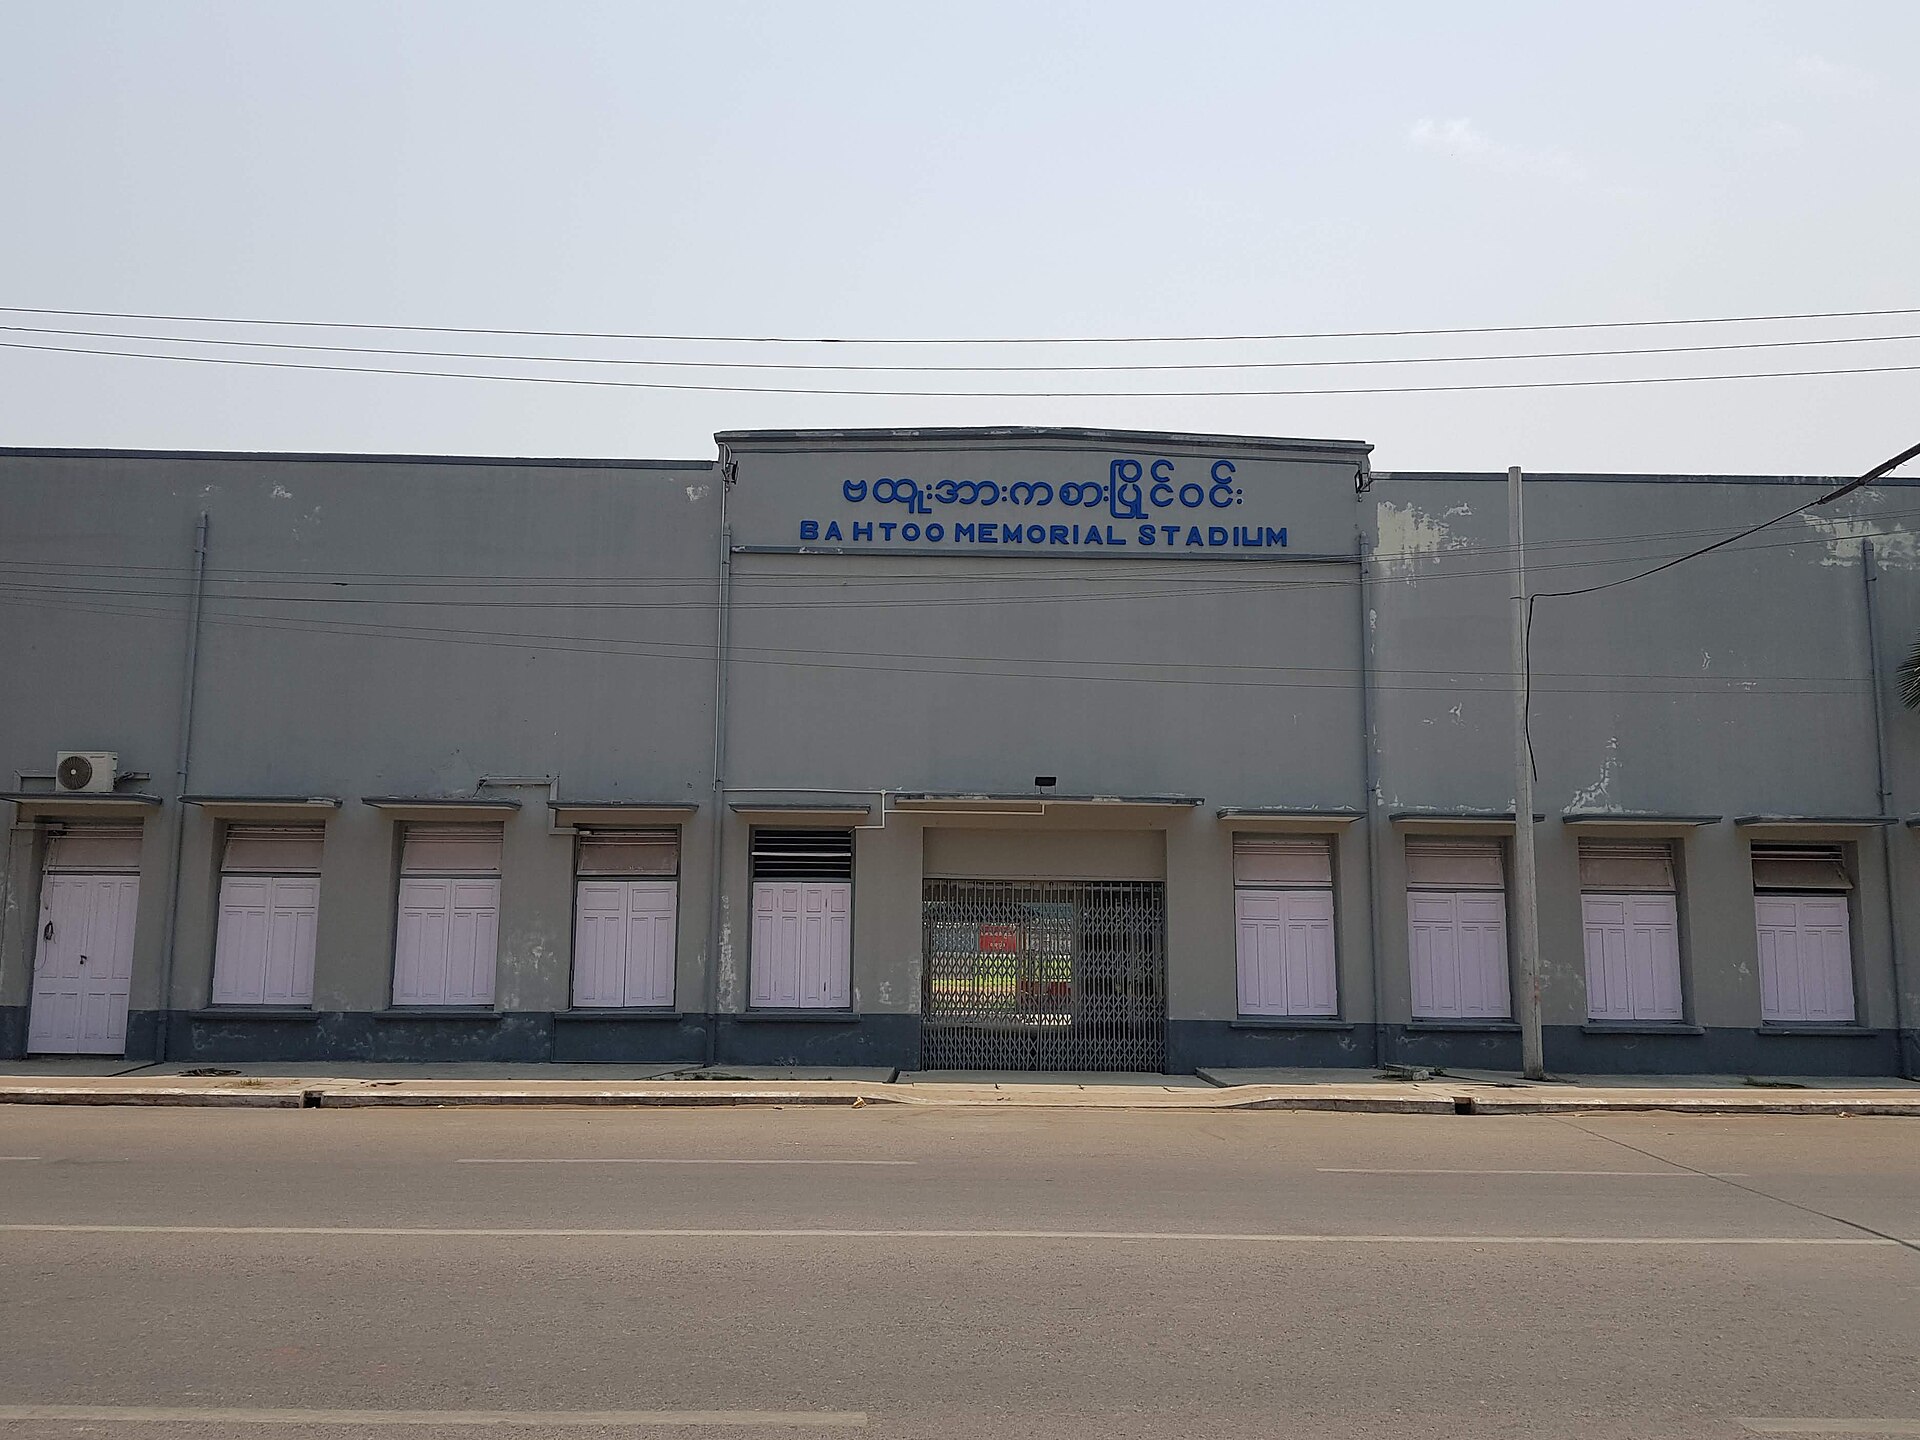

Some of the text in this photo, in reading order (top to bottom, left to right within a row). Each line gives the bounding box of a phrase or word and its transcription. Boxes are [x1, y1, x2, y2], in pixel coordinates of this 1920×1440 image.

[799, 519, 1288, 547] BAHTOO MEMORIAL STADIUM
